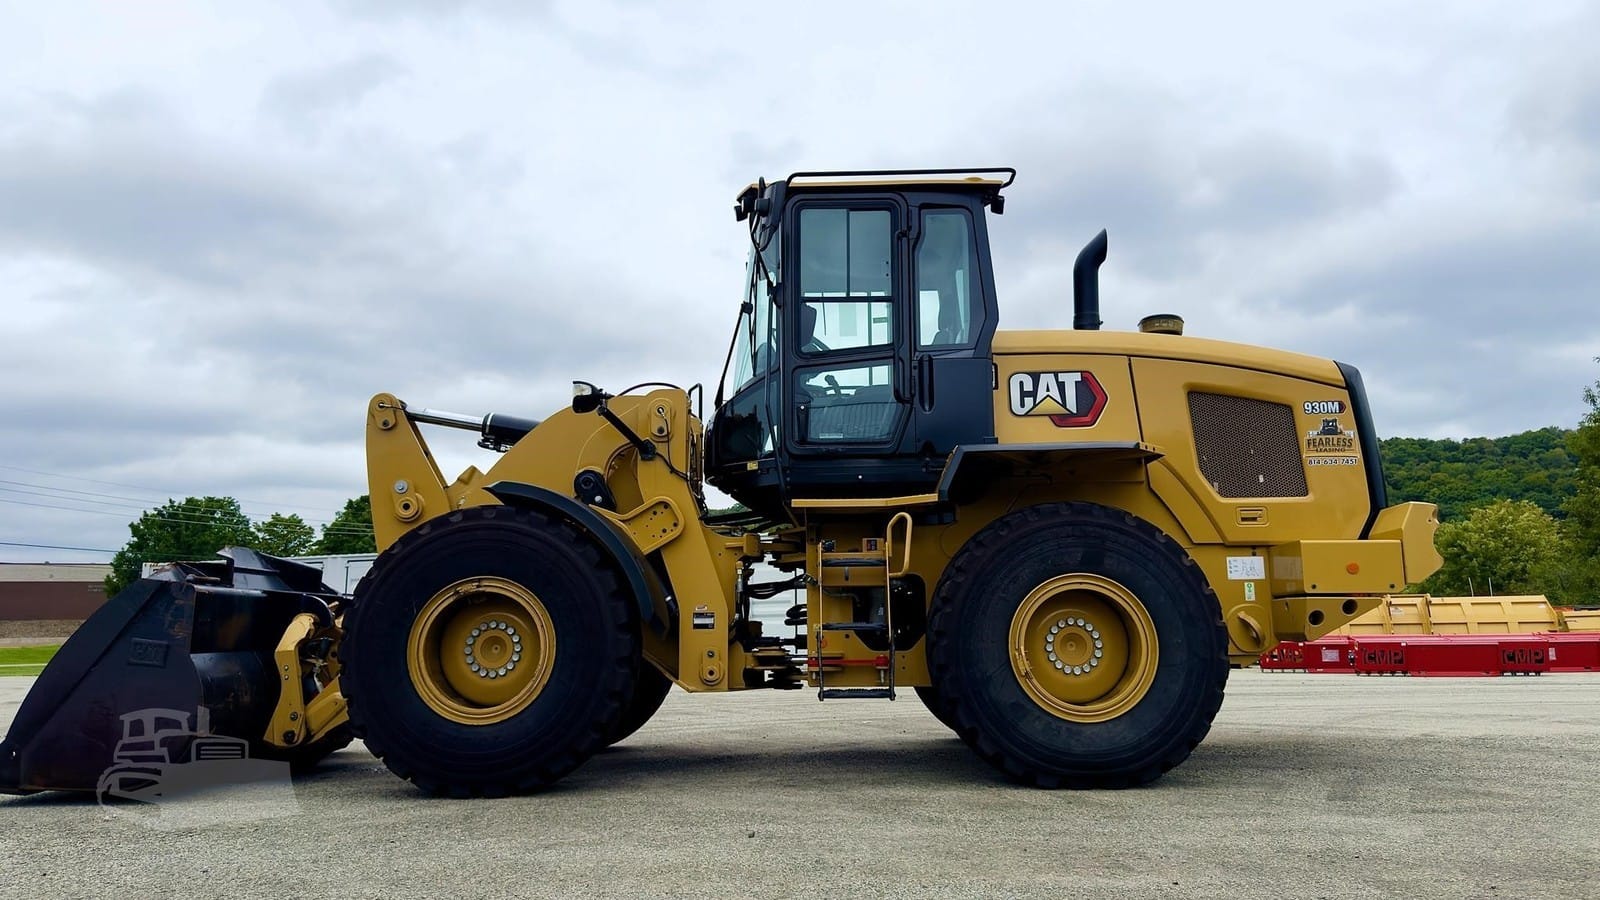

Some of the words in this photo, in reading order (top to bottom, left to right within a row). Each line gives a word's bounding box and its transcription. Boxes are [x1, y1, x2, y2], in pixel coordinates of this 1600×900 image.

[1010, 372, 1081, 415] CAT
[1304, 401, 1340, 414] 930M
[1306, 437, 1353, 449] FEARLESS
